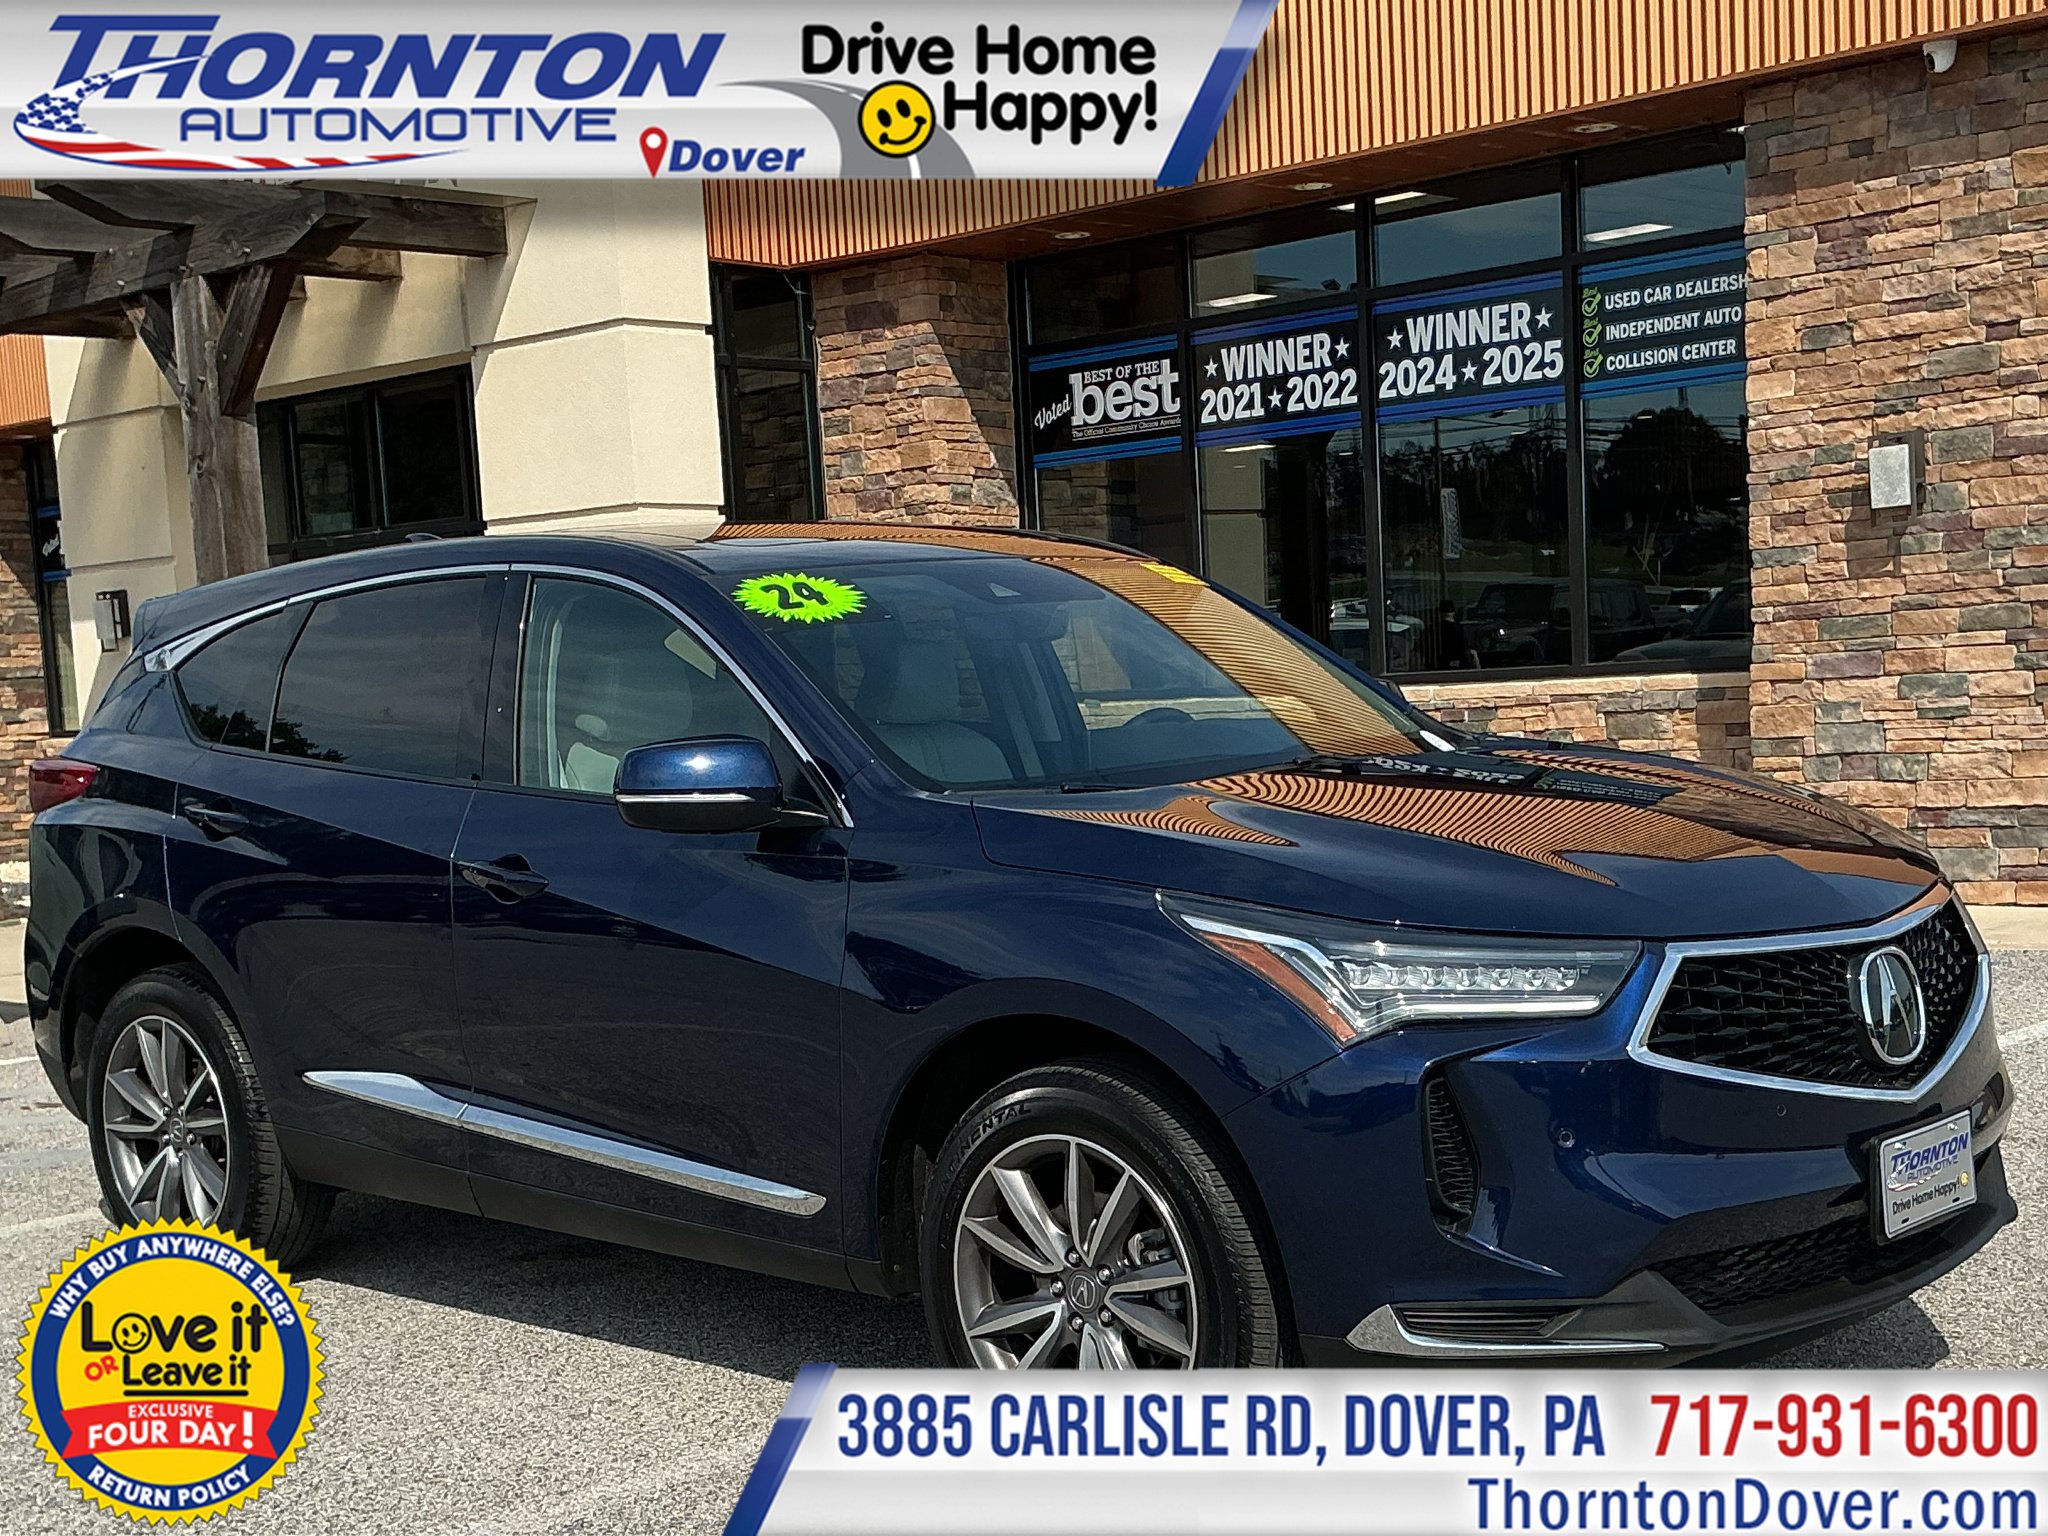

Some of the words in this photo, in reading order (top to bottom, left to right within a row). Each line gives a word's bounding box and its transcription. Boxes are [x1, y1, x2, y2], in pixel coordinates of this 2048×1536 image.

[1605, 291, 1640, 310] USED
[1644, 286, 1671, 303] CAR
[1406, 302, 1531, 353] WINNER
[1605, 312, 1700, 341] INDEPENDENT
[1704, 306, 1742, 327] AUTO
[1084, 368, 1113, 384] BEST
[1116, 365, 1132, 379] OF
[1135, 361, 1159, 376] THE
[1221, 332, 1331, 382] WINNER
[1379, 354, 1456, 399] 2024
[1482, 340, 1564, 386] 2025
[1606, 347, 1678, 371] COLLISION
[1682, 339, 1736, 360] CENTER
[1069, 358, 1180, 426] best
[1200, 382, 1265, 424] 2021
[1286, 369, 1358, 412] 2022
[1034, 394, 1072, 430] Voted
[1890, 1132, 1969, 1175] THORNTON
[1907, 1154, 1958, 1181] AUTOMOTIVE
[1892, 1196, 1911, 1215] Drive
[1912, 1189, 1933, 1208] Home
[1934, 1179, 1960, 1197] Happy!
